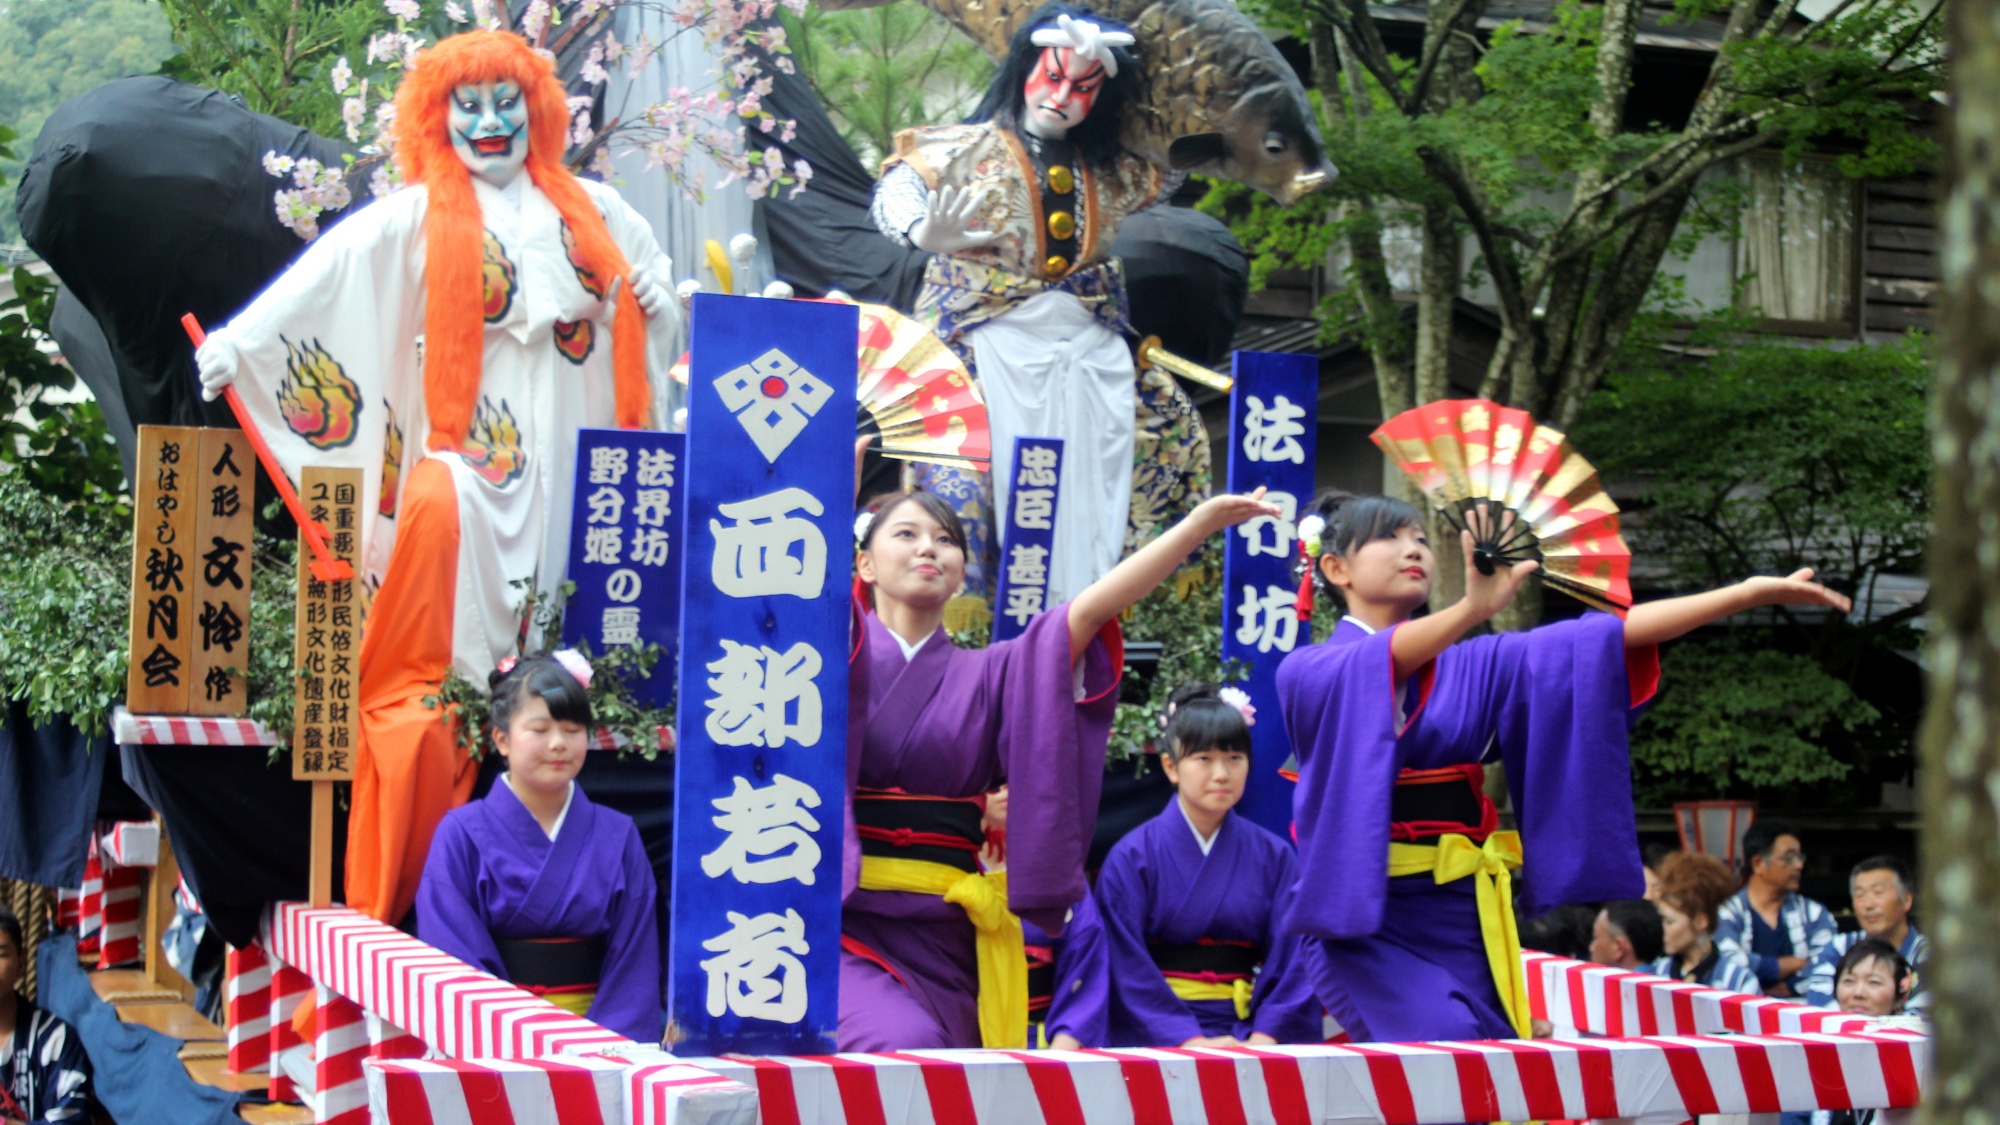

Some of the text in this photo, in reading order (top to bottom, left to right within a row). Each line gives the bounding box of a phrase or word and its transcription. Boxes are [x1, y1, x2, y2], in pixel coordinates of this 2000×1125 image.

[583, 446, 629, 565] 野分姫
[630, 448, 676, 567] 法界坊
[302, 483, 330, 773] ユネ無形文化遺産登録
[327, 483, 355, 773] 国重要形民俗文化財指定
